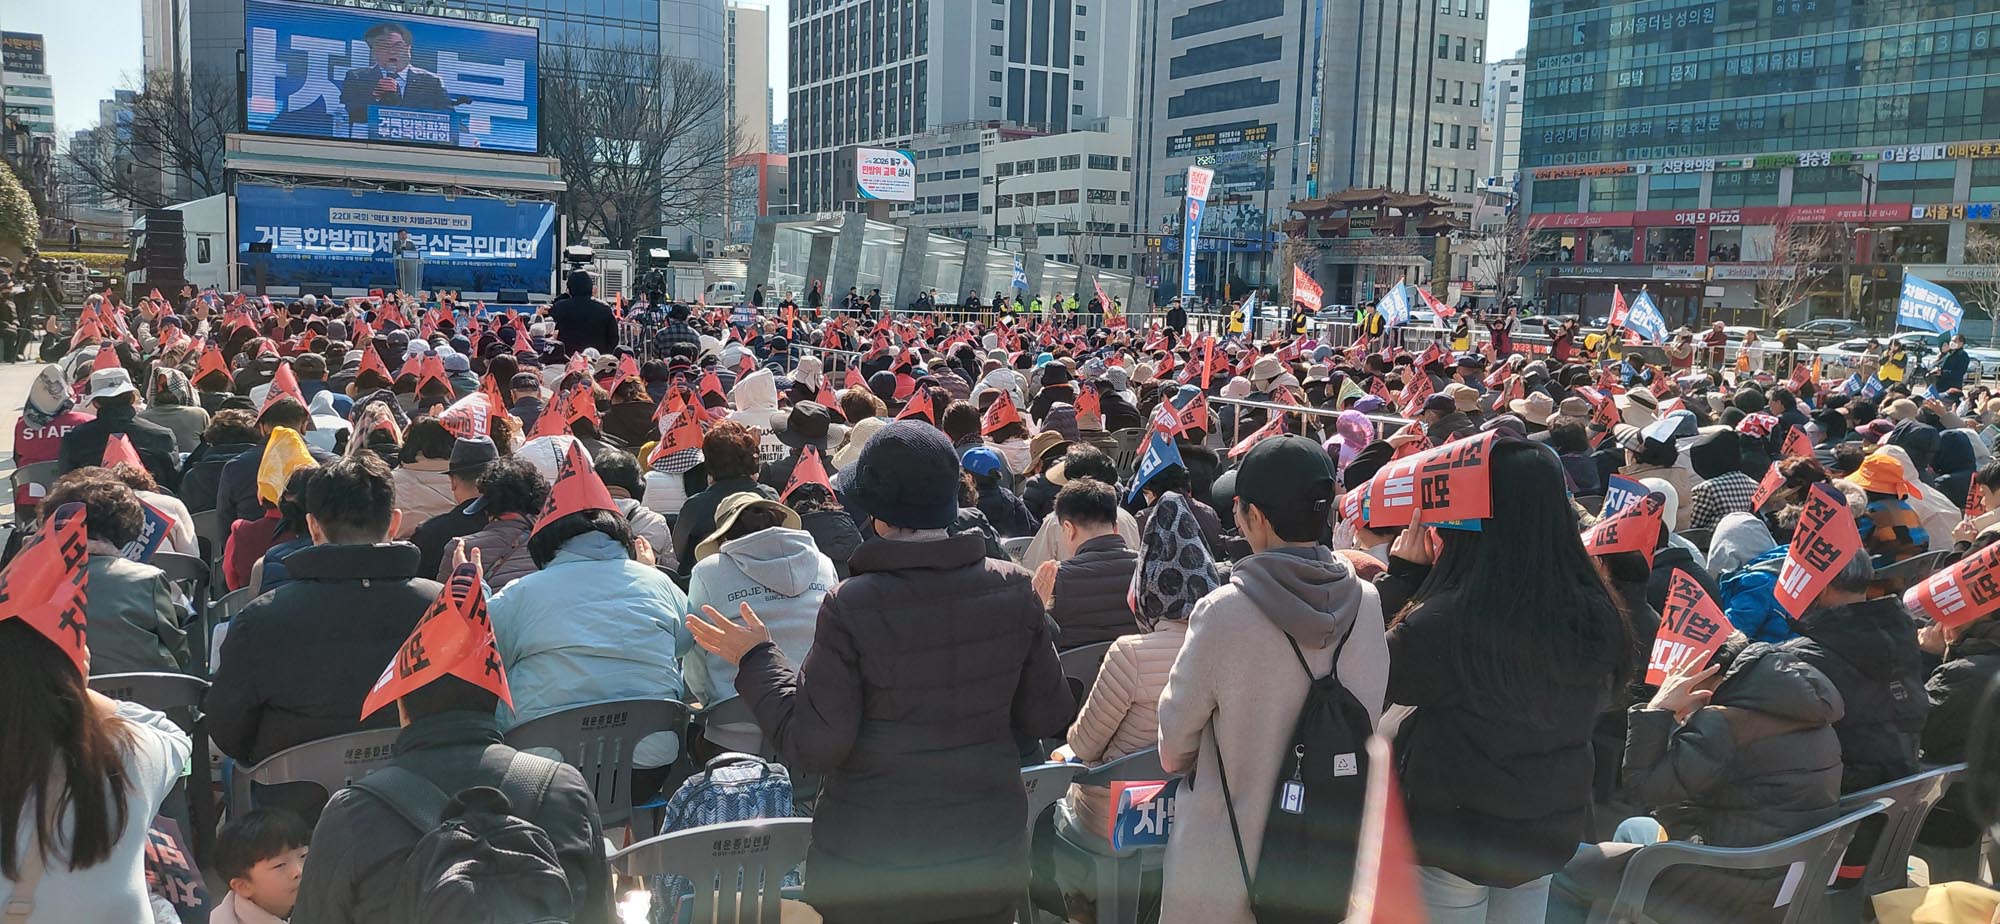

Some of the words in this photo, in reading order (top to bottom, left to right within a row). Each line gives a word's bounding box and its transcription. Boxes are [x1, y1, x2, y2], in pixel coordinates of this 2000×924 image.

[1623, 7, 1715, 34] 서울더남성의원
[1538, 52, 1583, 68] 남성수술
[1619, 69, 1644, 86] 도박
[1671, 63, 1697, 81] 문제
[1544, 121, 1652, 144] 삼성메디이비인후과
[1663, 158, 1715, 174] 신당한의원
[332, 212, 350, 221] 22대
[353, 212, 369, 222] 국회
[391, 215, 408, 224] 최악
[452, 218, 468, 227] 반대
[1675, 213, 1706, 225] 이재모
[1709, 211, 1740, 224] Pizza
[255, 226, 398, 254] 거룩한방파제
[408, 234, 538, 259] 부산국민대회
[1583, 266, 1603, 274] YOUNG
[1904, 283, 1962, 317] 차별금지법
[23, 425, 75, 440] STAF
[759, 444, 769, 453] ET
[772, 444, 784, 453] THE
[727, 586, 762, 602] GEOJE
[1661, 605, 1721, 645] 지법
